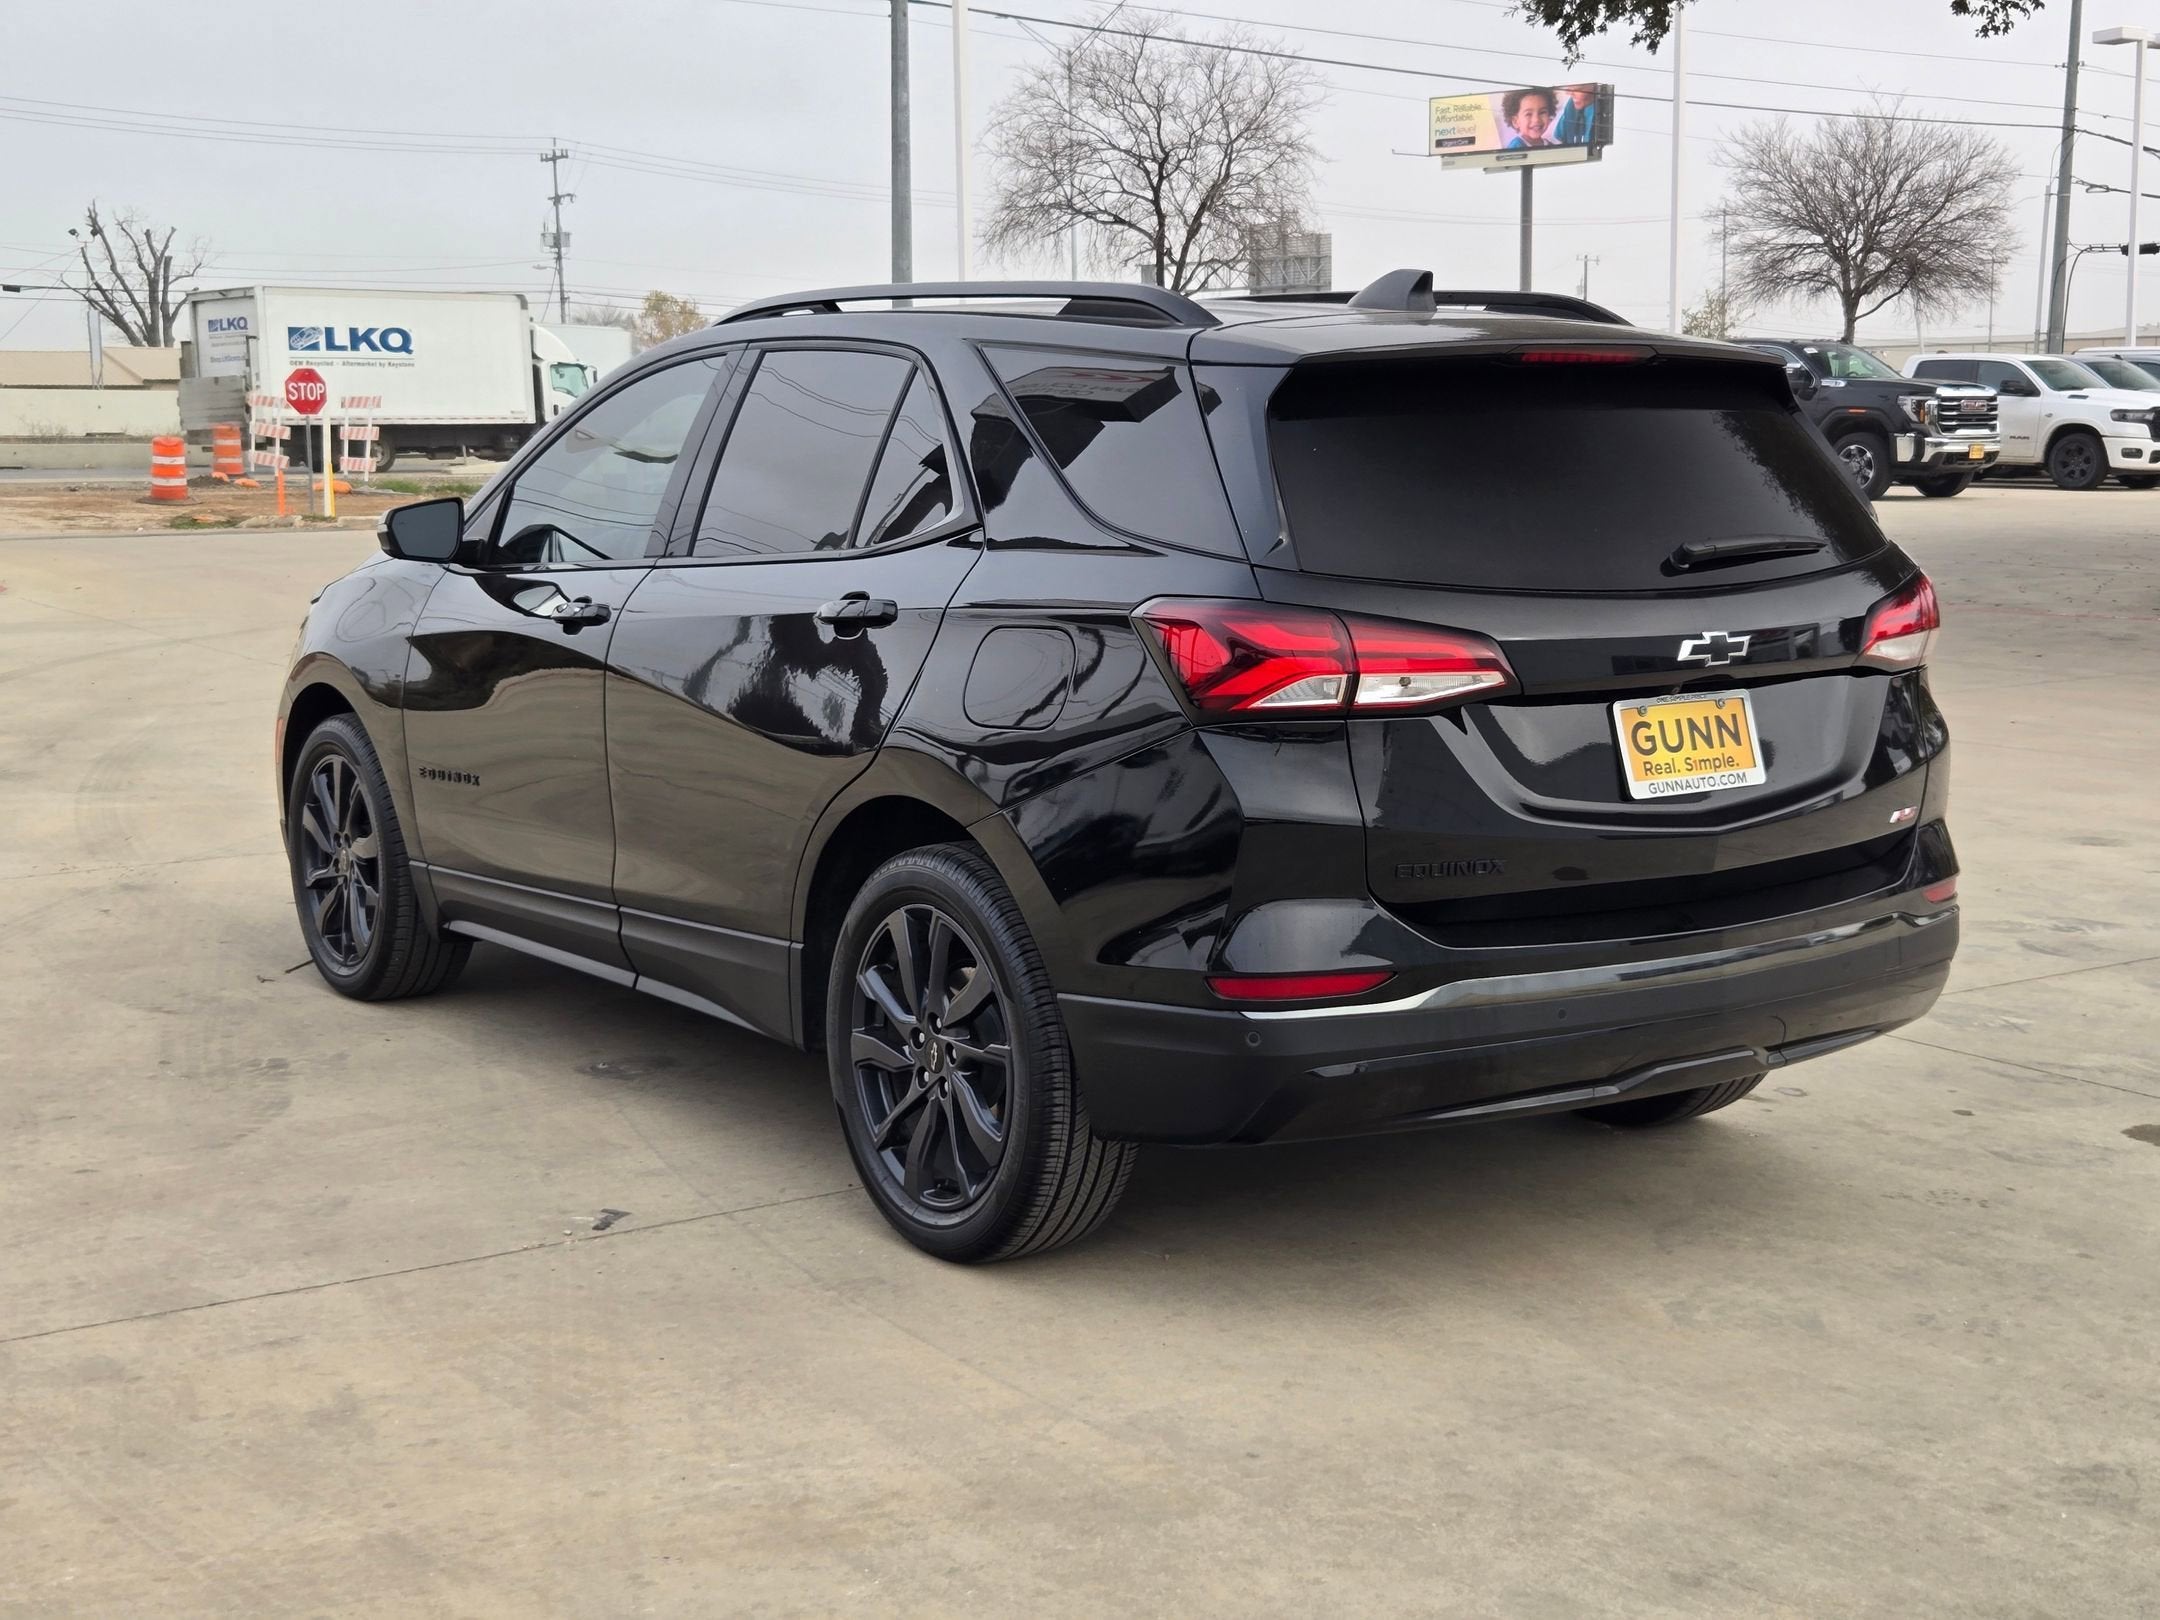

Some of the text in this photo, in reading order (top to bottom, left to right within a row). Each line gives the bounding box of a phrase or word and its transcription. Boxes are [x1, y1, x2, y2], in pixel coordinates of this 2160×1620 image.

[1434, 126, 1456, 137] next
[219, 316, 248, 331] LKQ
[324, 327, 414, 354] LKQ
[288, 382, 325, 401] STOP
[1631, 714, 1742, 756] GUNN
[419, 766, 481, 787] EQUINOX
[1643, 758, 1682, 777] Real.
[1648, 771, 1748, 795] GUNNAUTO.COM
[1394, 859, 1507, 879] EQUINOX
